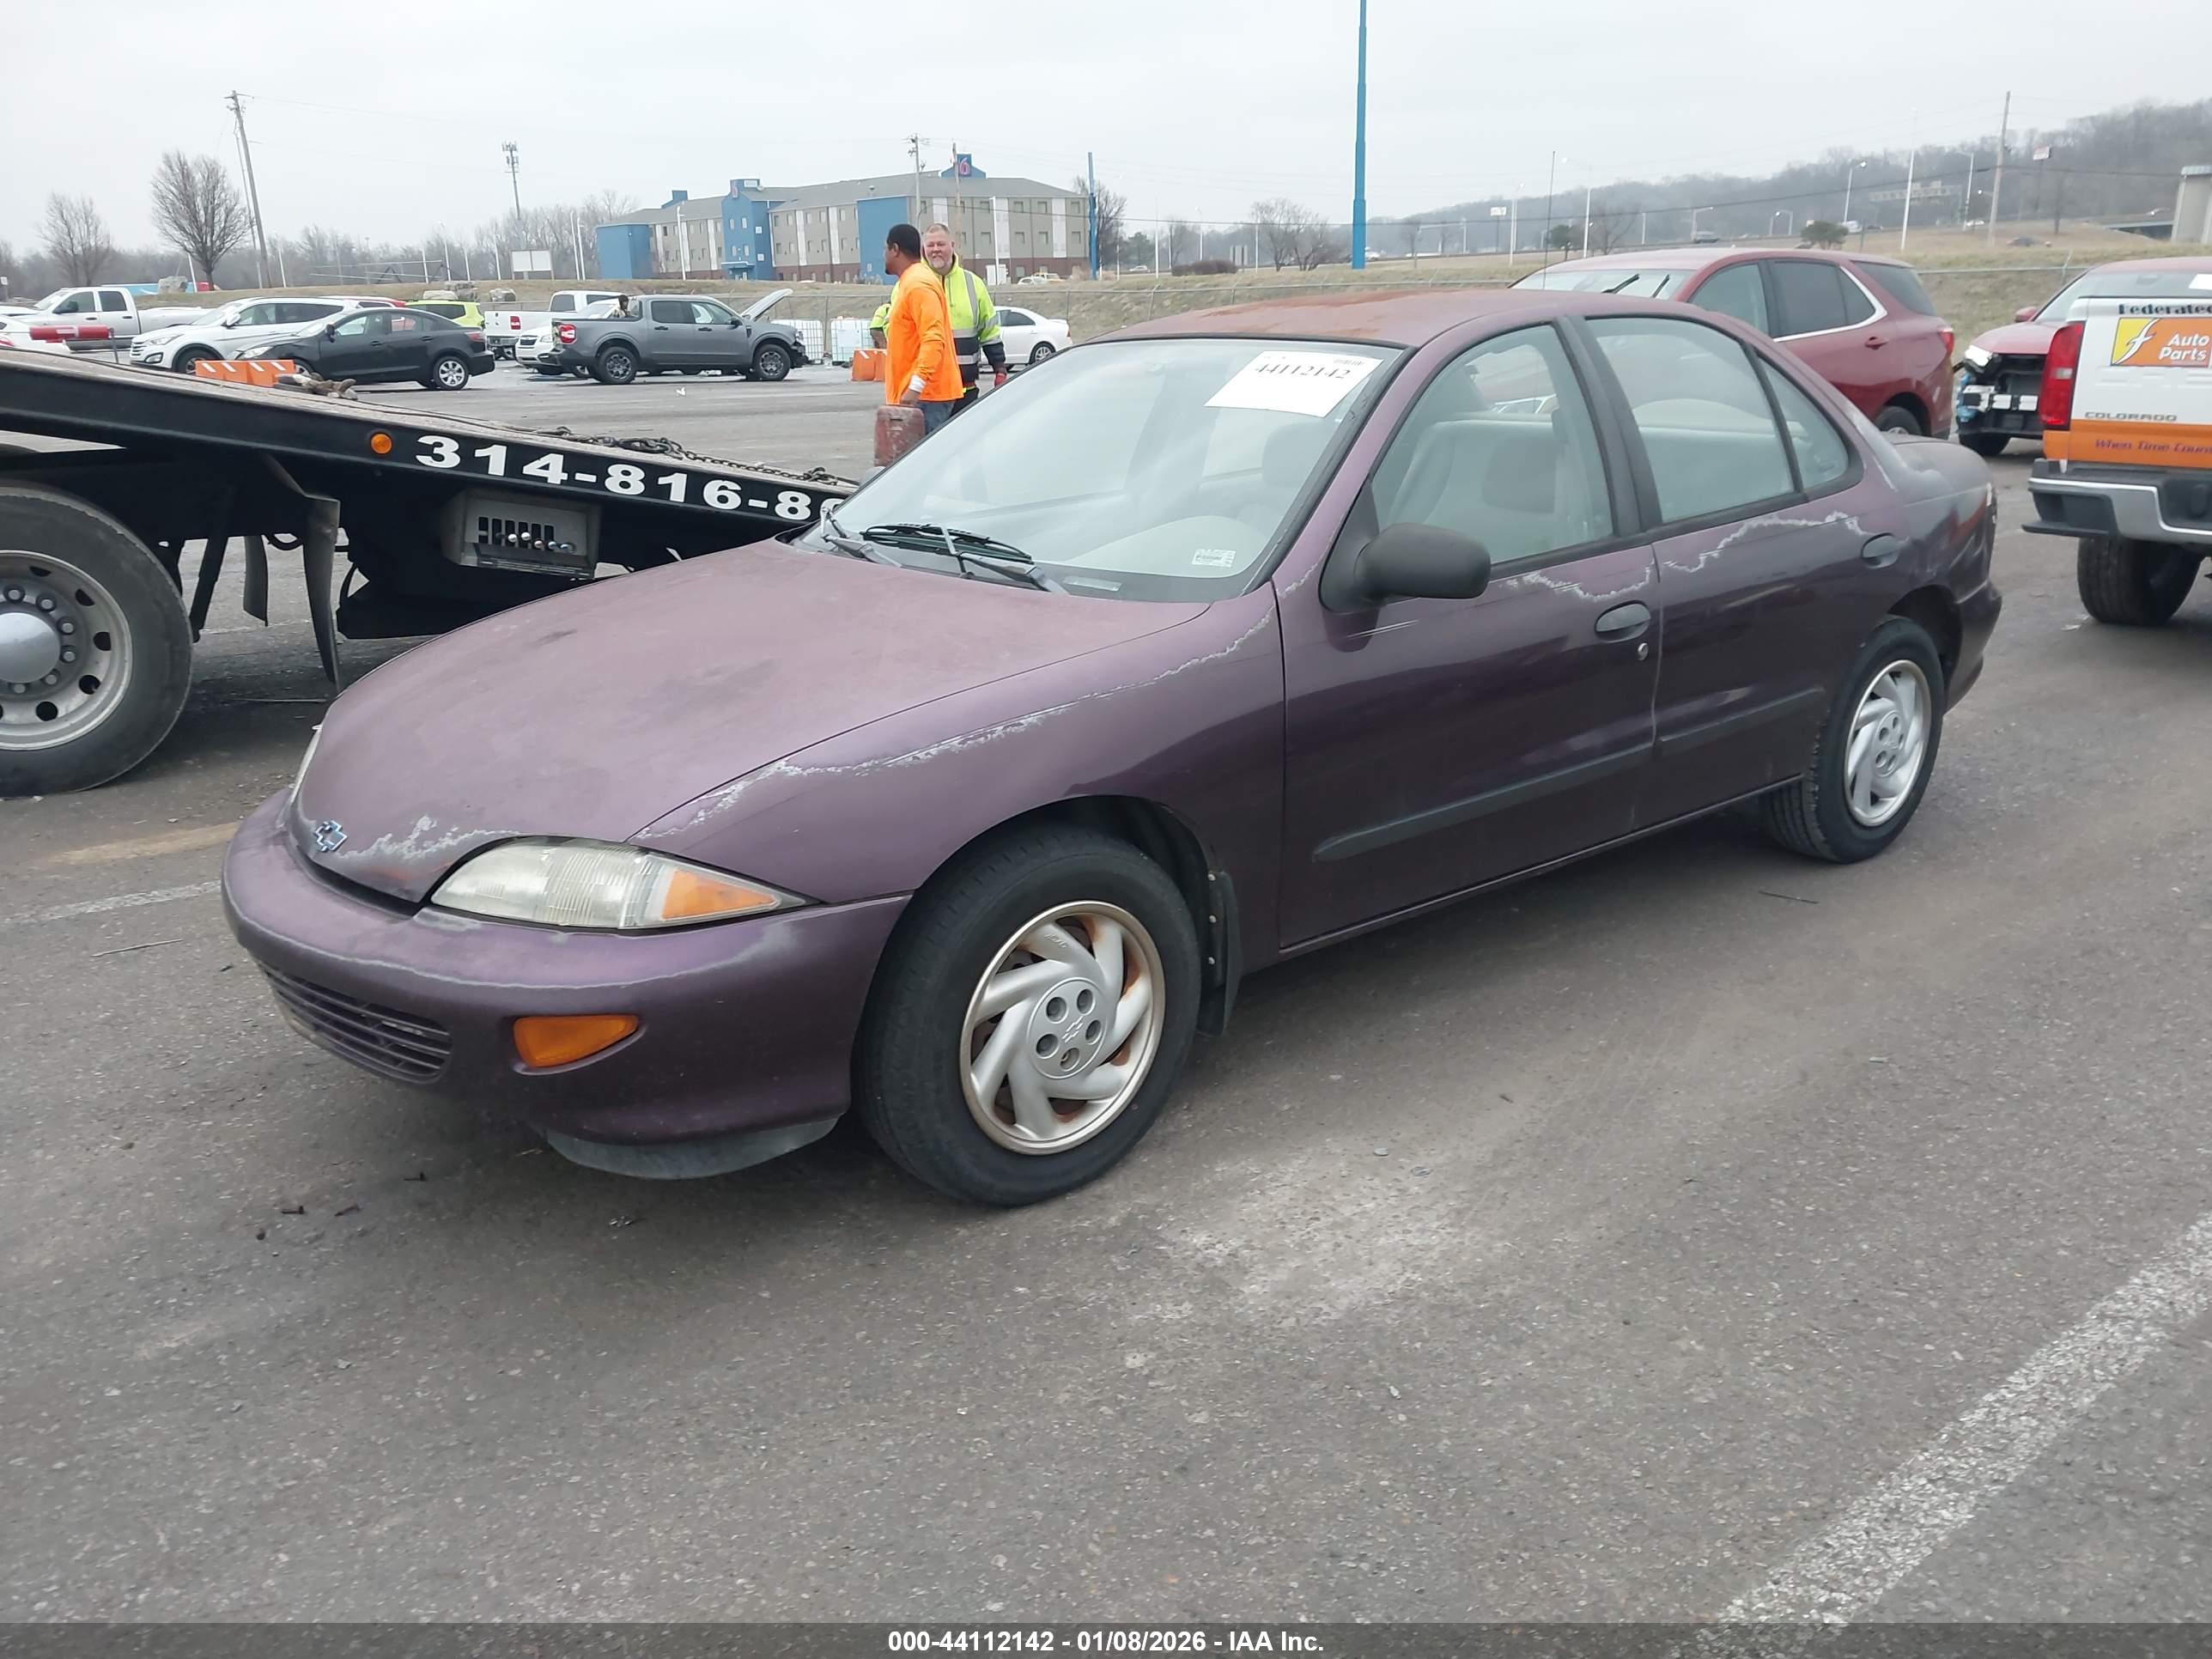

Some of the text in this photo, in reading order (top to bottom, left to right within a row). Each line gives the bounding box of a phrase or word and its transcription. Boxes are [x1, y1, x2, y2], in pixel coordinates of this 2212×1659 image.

[2166, 333, 2210, 347] Auto
[2158, 346, 2208, 362] Parts
[1255, 363, 1352, 380] 44112142
[2084, 411, 2178, 422] COLORADO
